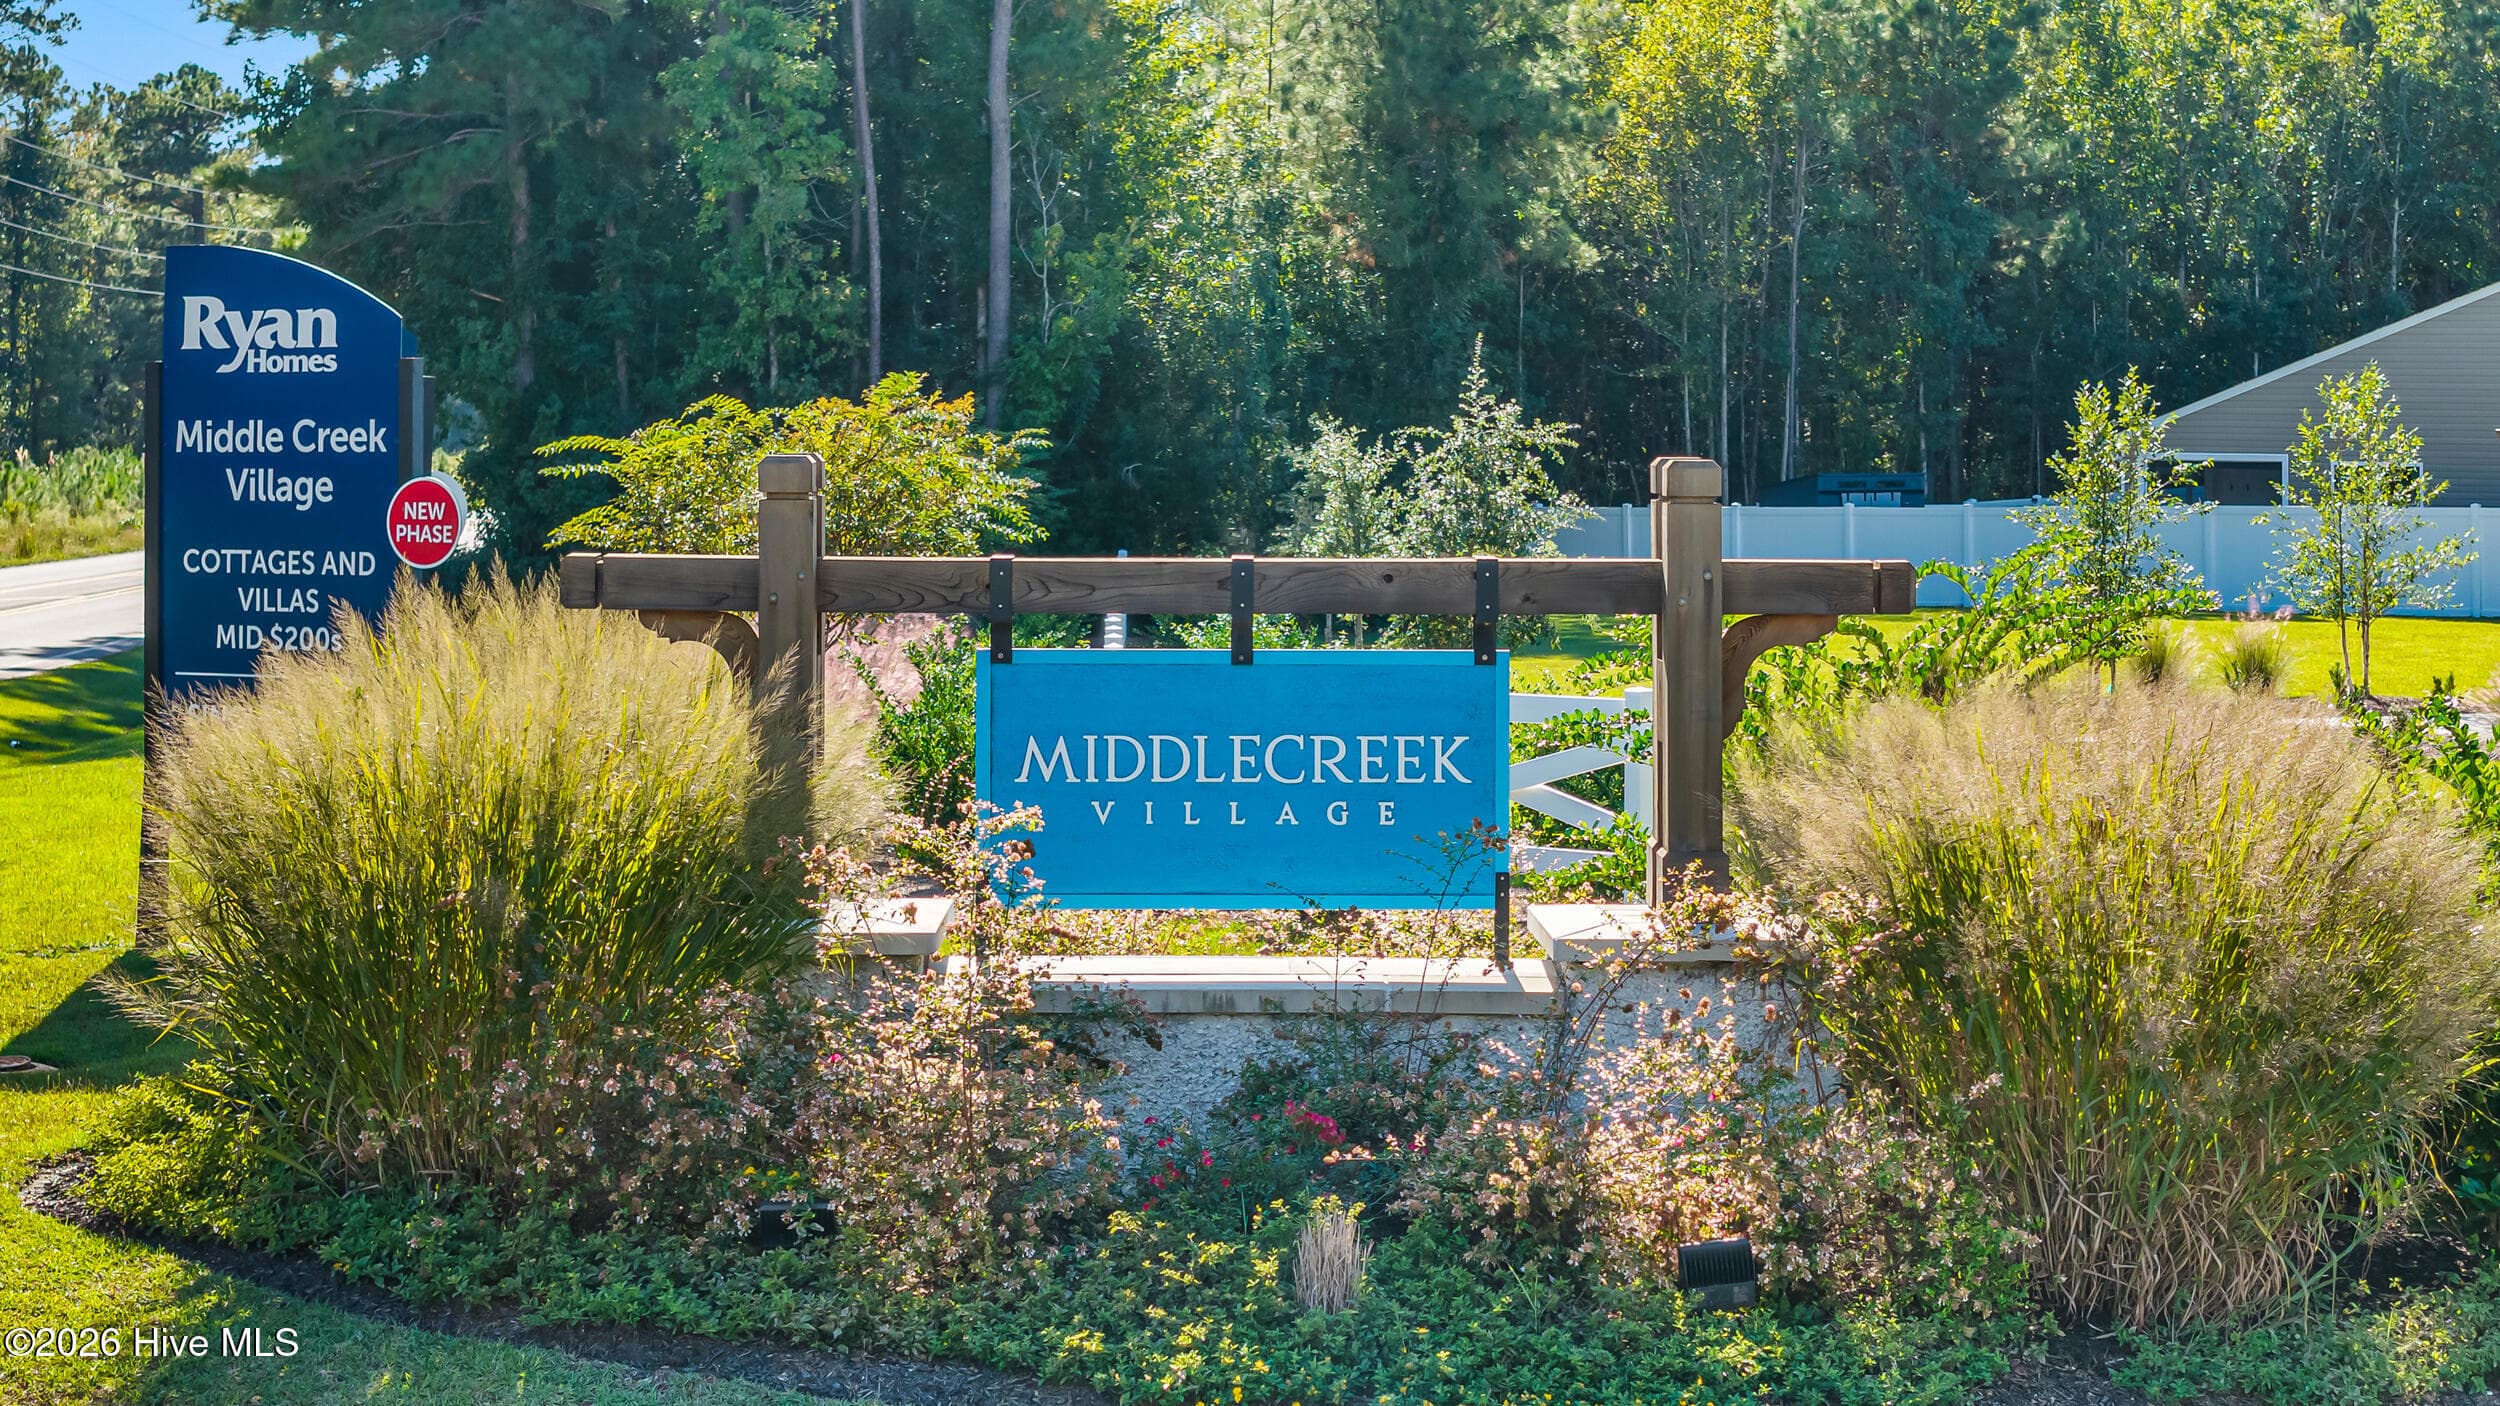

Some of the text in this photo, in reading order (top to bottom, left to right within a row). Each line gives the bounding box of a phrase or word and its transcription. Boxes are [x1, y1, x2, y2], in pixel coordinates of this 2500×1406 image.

[181, 296, 338, 373] Ryan
[246, 349, 338, 374] Homes
[175, 418, 387, 454] Middle Creek
[226, 468, 334, 511] Village
[403, 501, 446, 521] NEW
[395, 524, 453, 544] PHASE
[182, 549, 376, 577] COTTAGES AND
[237, 587, 320, 613] VILLAS
[216, 623, 343, 653] MID $200s
[1014, 735, 1472, 784] MIDDLECREEK
[1091, 801, 1396, 826] VILLAGE
